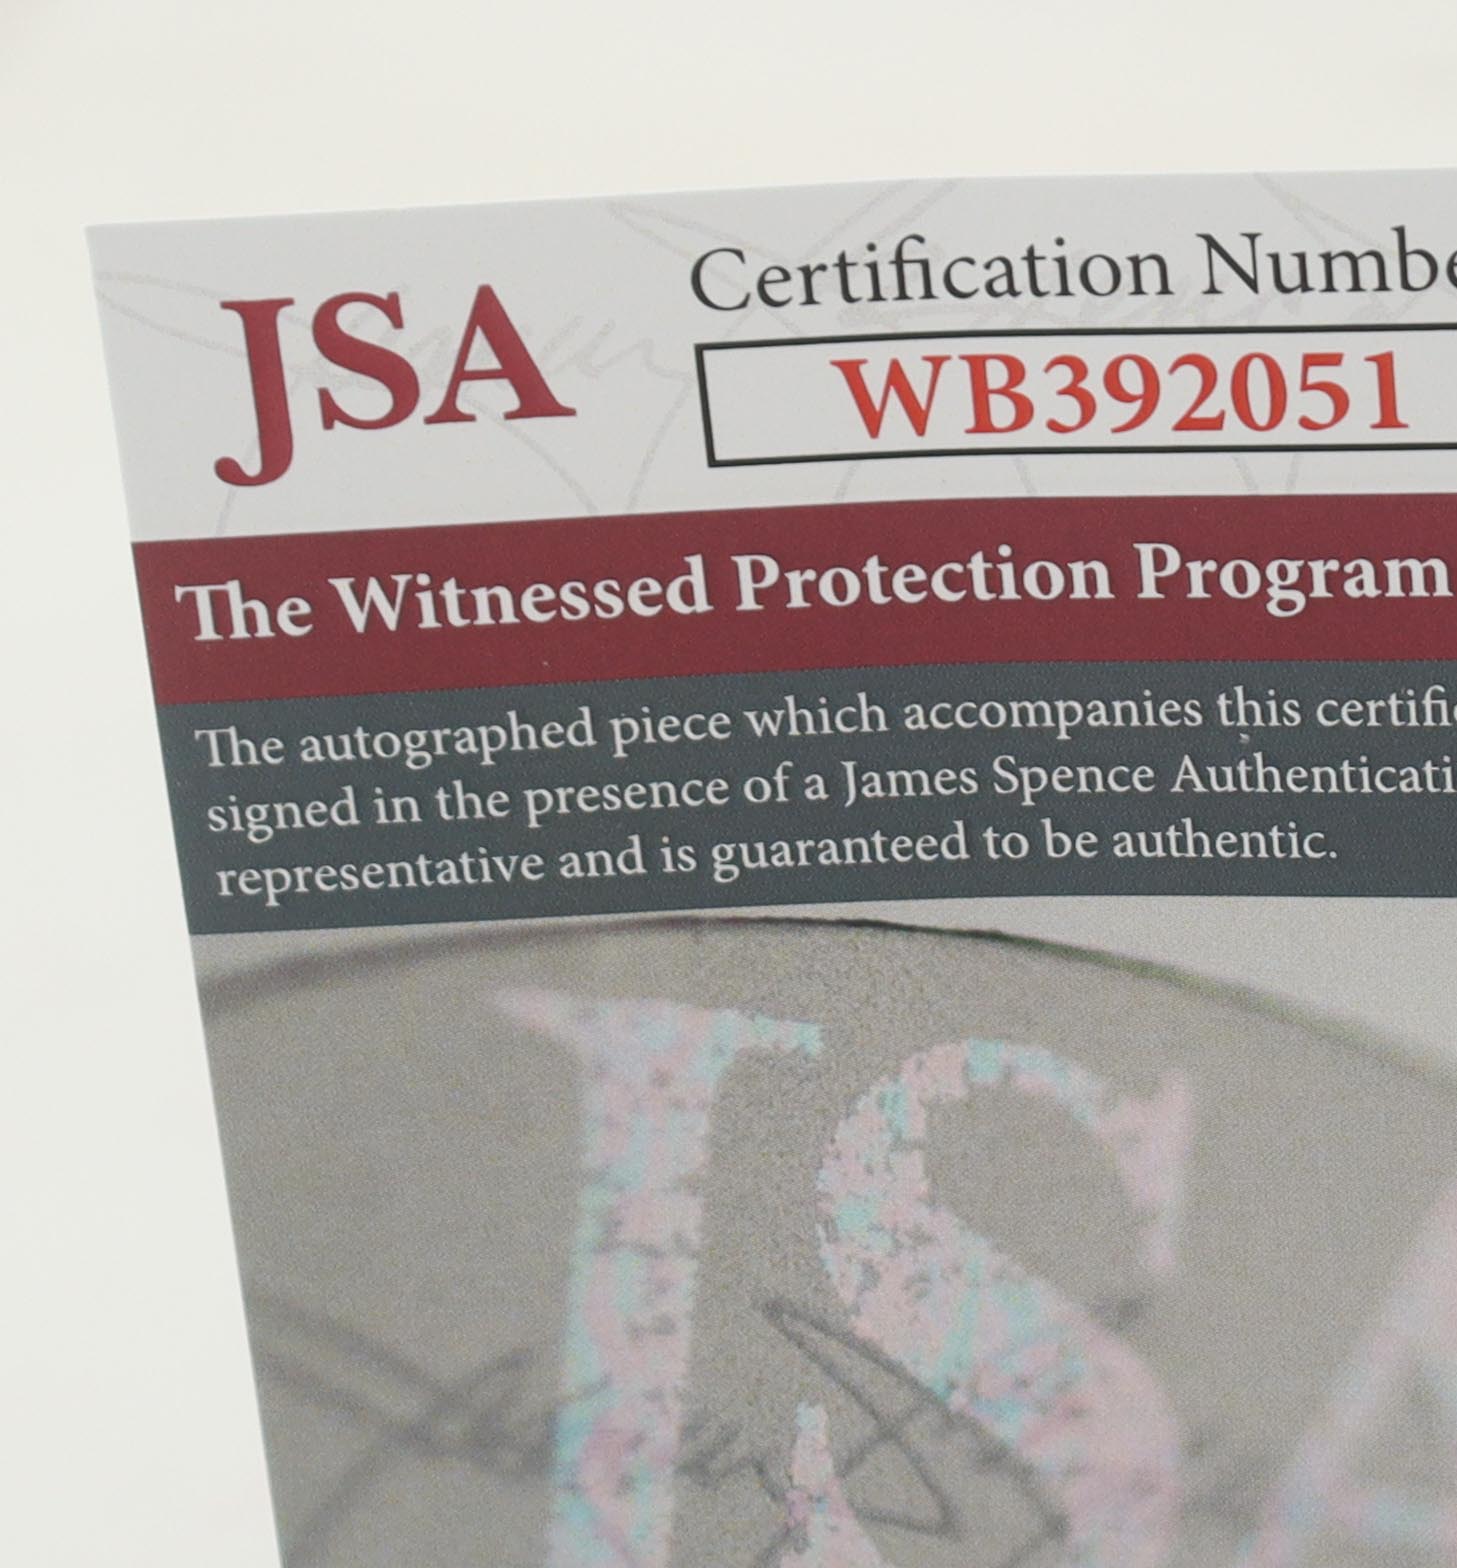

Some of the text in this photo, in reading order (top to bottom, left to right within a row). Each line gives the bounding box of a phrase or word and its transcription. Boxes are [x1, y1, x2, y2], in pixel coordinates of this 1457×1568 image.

[690, 234, 1174, 311] Certification
[213, 284, 577, 487] JSA
[829, 350, 1410, 439] WB392051
[174, 541, 1454, 641] The Witnessed Protection Program
[194, 725, 285, 768] The
[299, 706, 597, 771] autographed
[608, 706, 732, 757] piece
[741, 692, 889, 739] which
[904, 688, 1203, 740] accompanies
[1217, 686, 1301, 728] this
[207, 785, 360, 844] signed
[373, 796, 422, 825] in
[433, 778, 510, 822] the
[525, 768, 730, 829] presence
[742, 760, 795, 803] of
[802, 771, 829, 800] a
[840, 760, 979, 808] James
[992, 752, 1156, 806] Spence
[215, 816, 1337, 906] representative and is guaranteed to be authentic.
